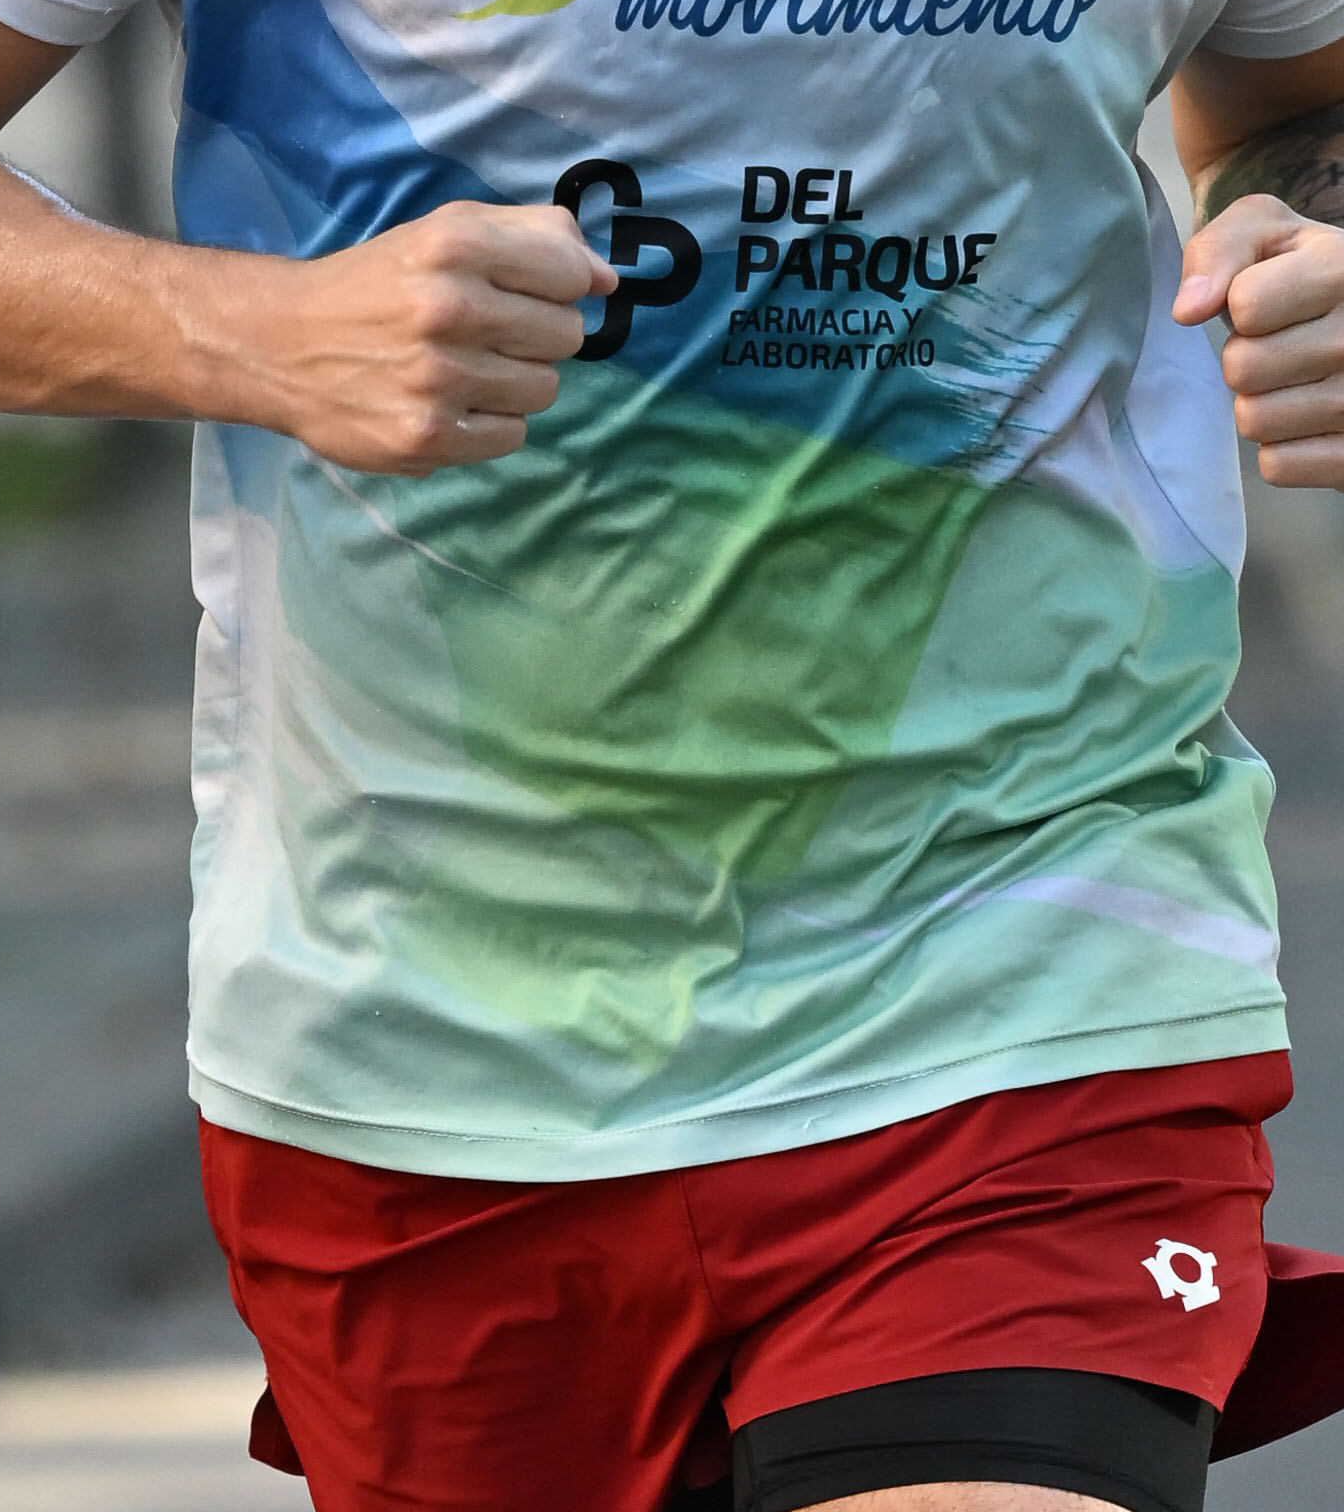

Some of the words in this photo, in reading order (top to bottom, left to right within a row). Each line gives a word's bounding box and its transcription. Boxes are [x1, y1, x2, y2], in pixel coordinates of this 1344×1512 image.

[741, 166, 863, 224] DEL
[735, 233, 997, 303] PARQUE
[728, 306, 895, 336] FARMACIA
[902, 308, 923, 334] Y
[721, 339, 935, 370] LABORATORIO
